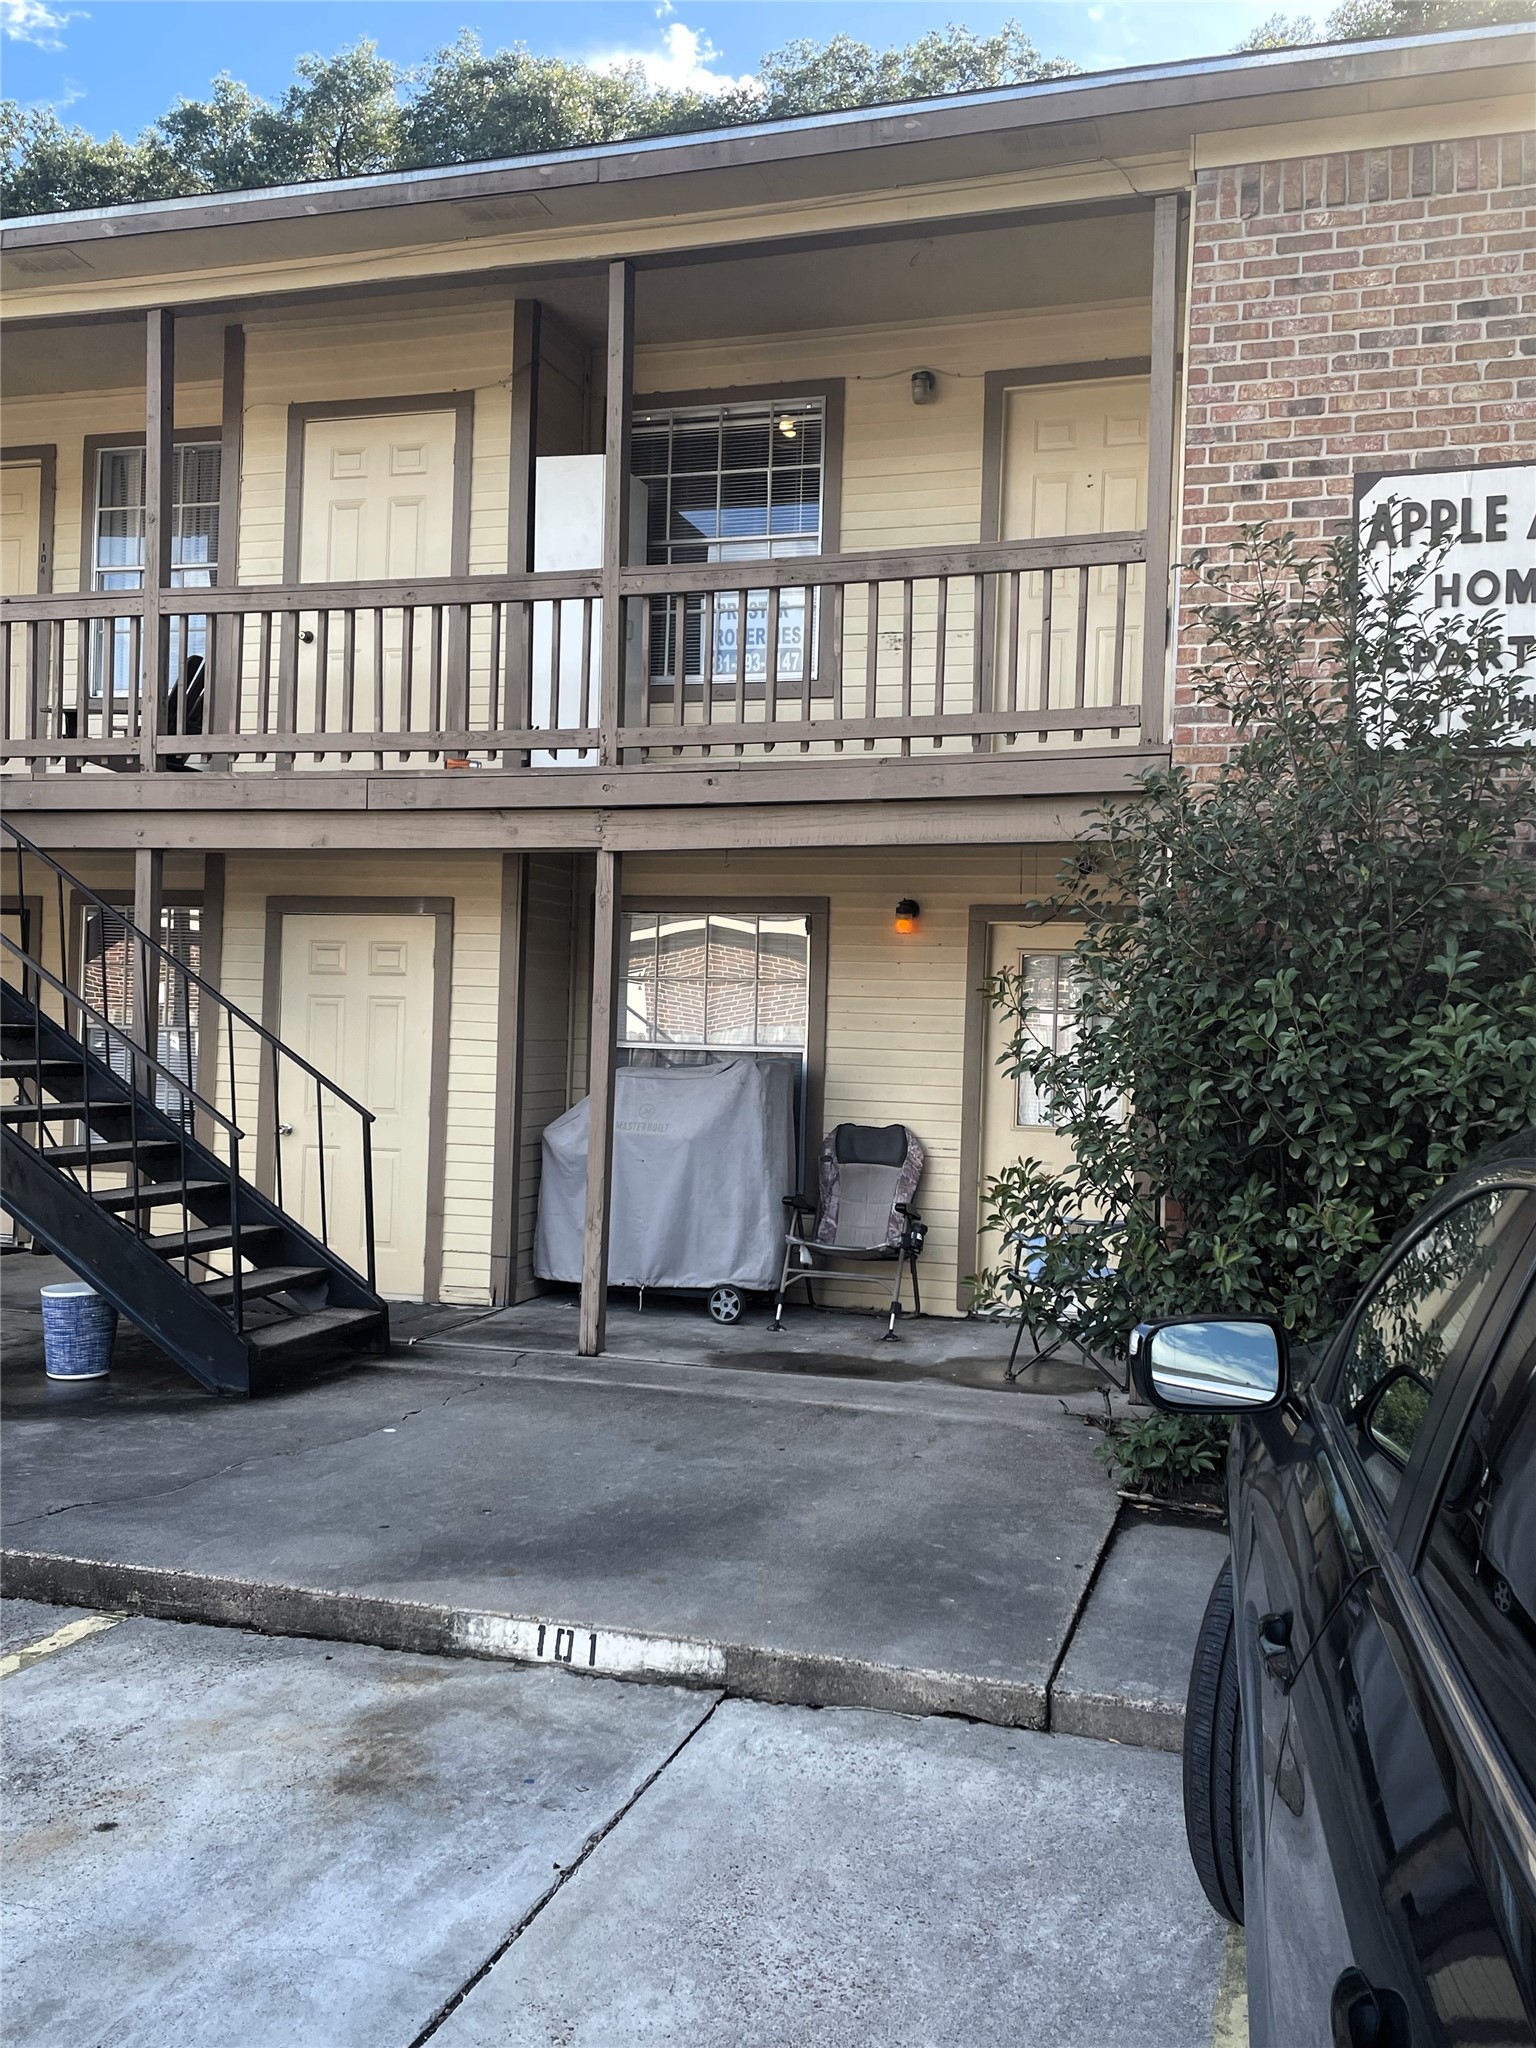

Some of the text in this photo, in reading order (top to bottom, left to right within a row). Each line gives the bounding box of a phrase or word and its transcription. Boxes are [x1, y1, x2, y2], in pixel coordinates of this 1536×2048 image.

[1366, 495, 1507, 550] APPLE
[717, 600, 789, 620] PRSTR
[616, 1121, 669, 1133] MASTERBUILT
[537, 1624, 597, 1667] 101
